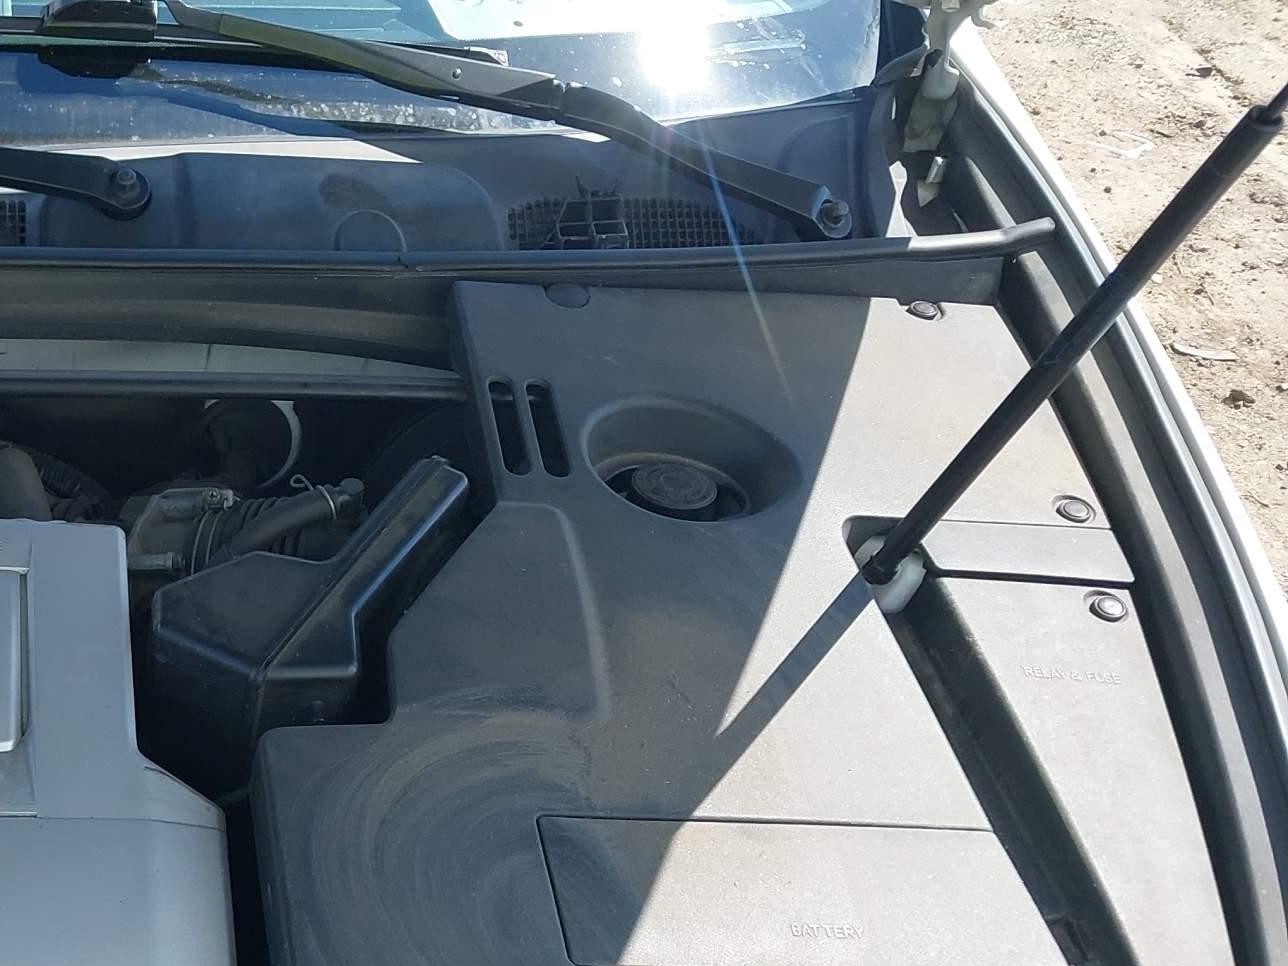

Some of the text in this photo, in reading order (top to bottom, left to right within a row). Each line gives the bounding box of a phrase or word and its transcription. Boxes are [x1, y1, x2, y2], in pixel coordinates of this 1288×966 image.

[1022, 666, 1121, 685] RELAY & FUSE
[791, 923, 864, 938] BATTERY
